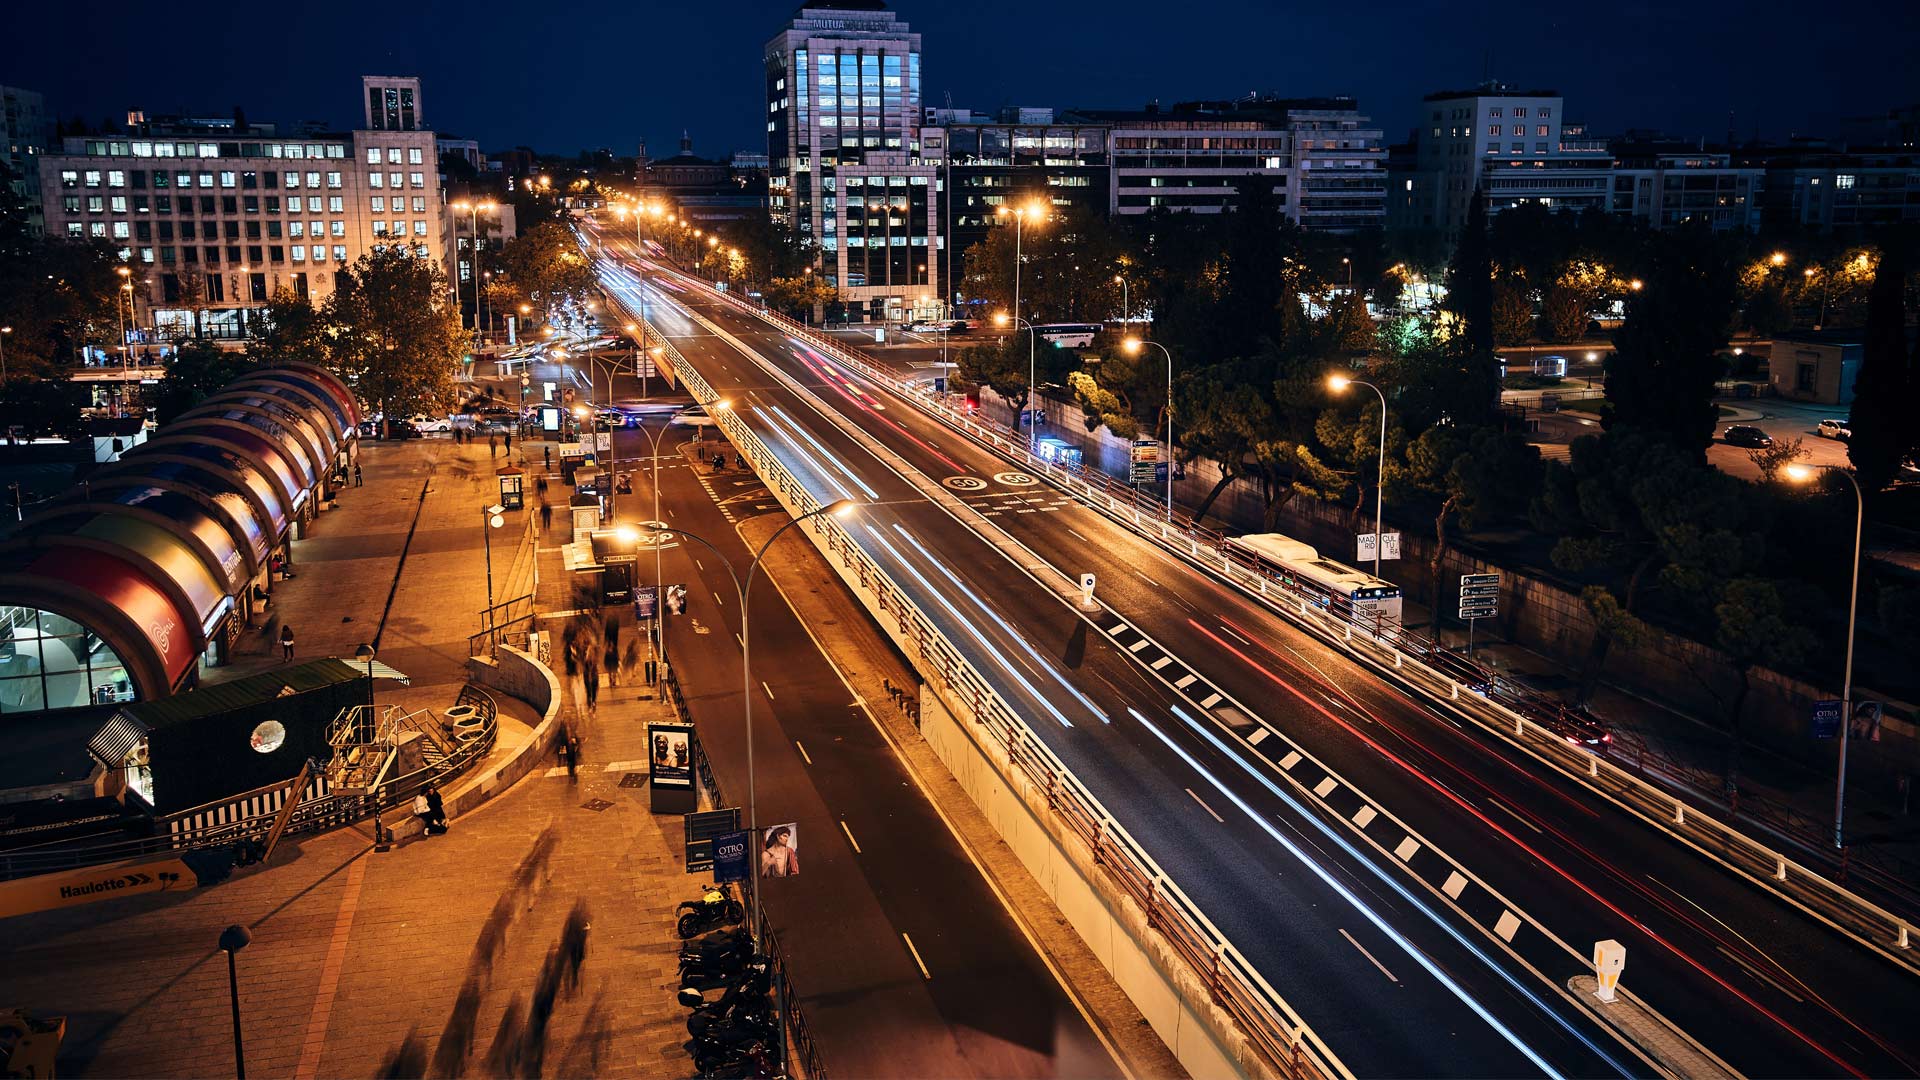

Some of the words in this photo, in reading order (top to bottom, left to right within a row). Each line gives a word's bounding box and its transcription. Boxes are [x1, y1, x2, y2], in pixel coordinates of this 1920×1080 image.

[952, 479, 978, 488] 50
[1004, 475, 1030, 483] 50
[1358, 535, 1375, 544] MAD
[1382, 535, 1396, 543] CUL
[719, 843, 744, 855] OTRO
[60, 879, 126, 899] Haulotte
